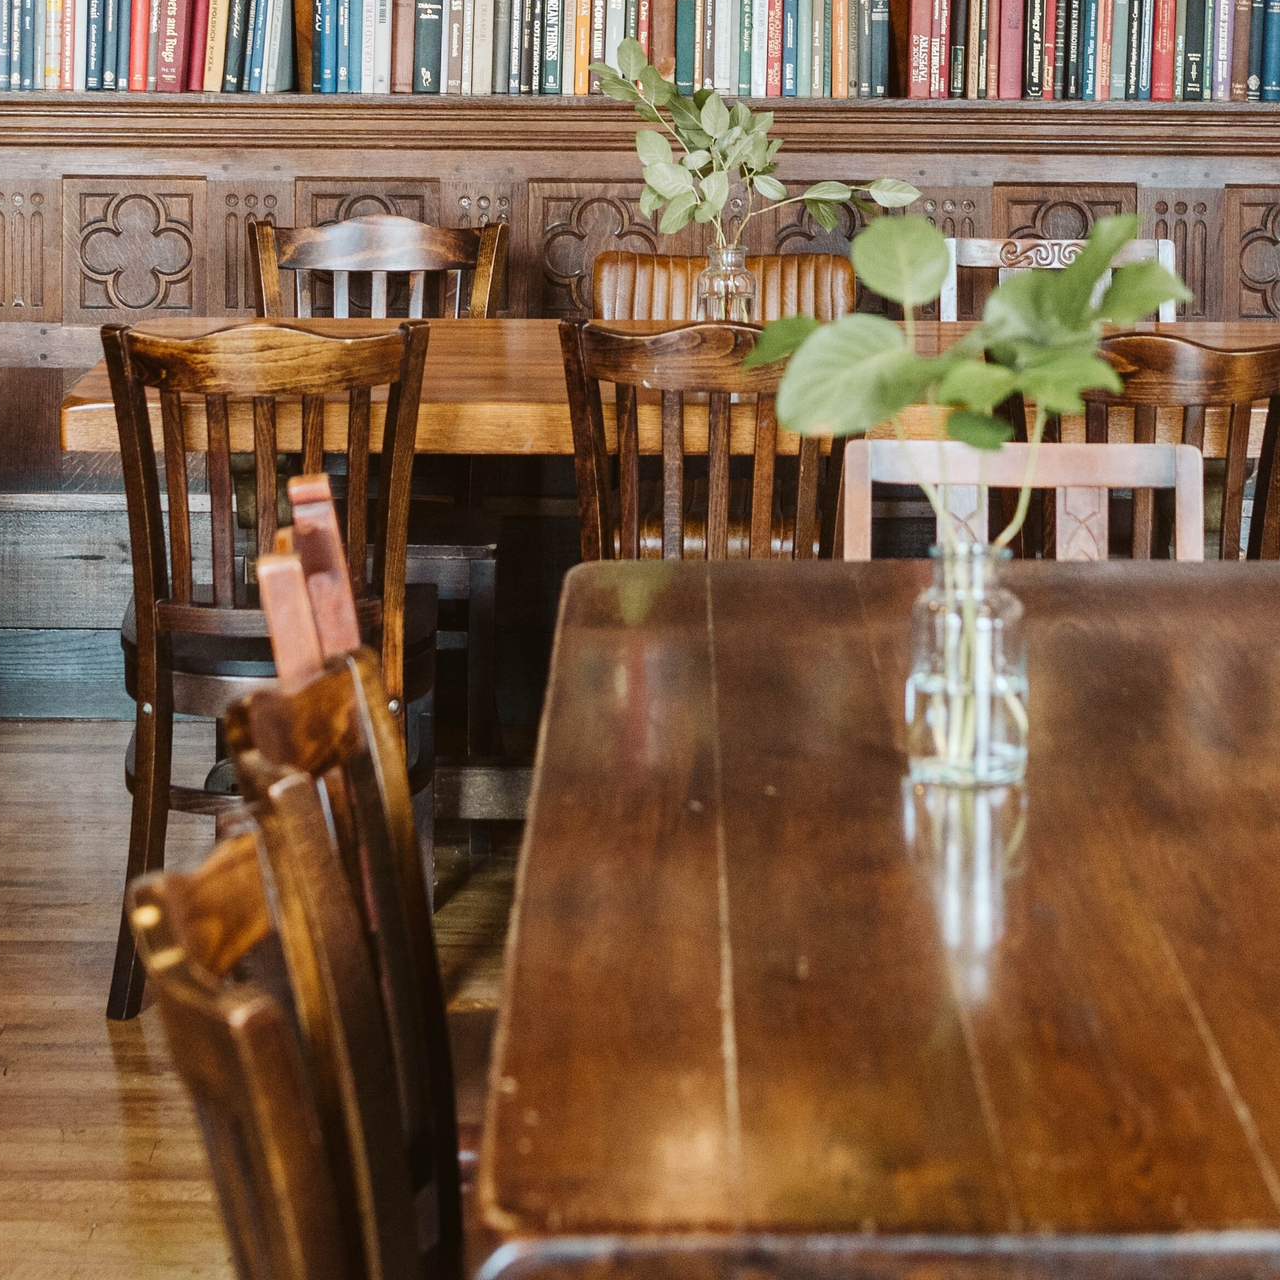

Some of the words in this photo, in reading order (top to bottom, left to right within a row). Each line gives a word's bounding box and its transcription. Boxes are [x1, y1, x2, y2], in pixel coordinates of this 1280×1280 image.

[166, 20, 178, 36] and
[1034, 33, 1042, 42] of
[163, 38, 177, 62] Rugs
[547, 26, 560, 60] THINGS
[1032, 43, 1042, 83] Railways
